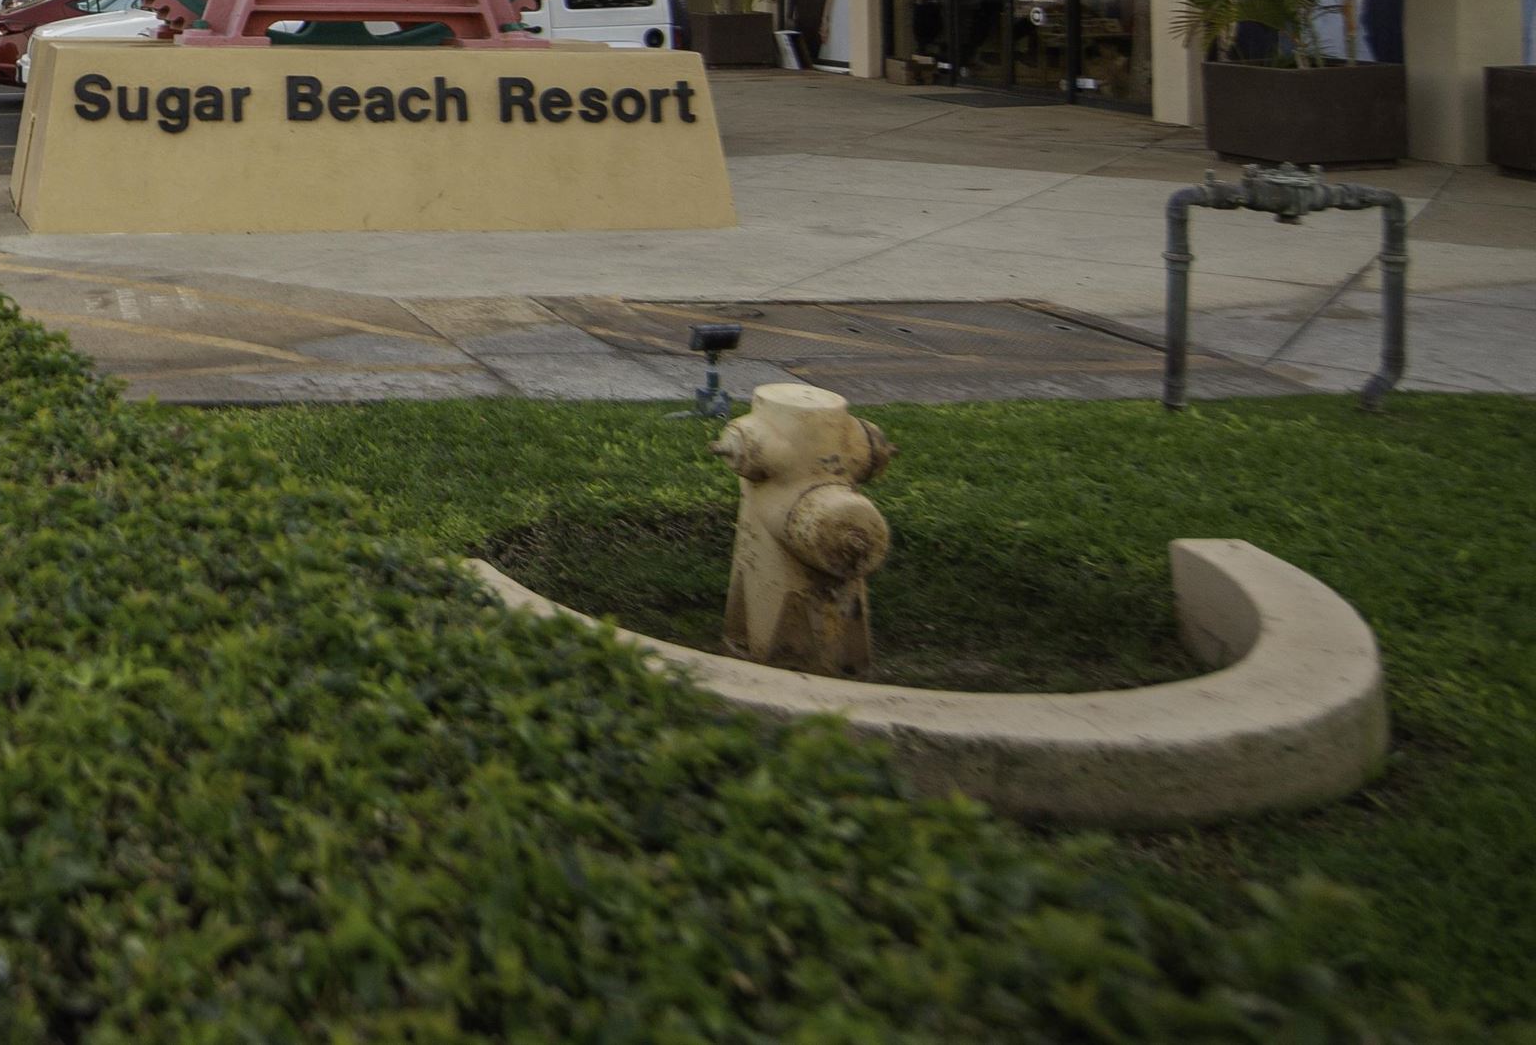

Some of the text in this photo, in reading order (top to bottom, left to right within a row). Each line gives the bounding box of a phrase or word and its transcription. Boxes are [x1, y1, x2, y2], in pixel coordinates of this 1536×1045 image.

[74, 73, 696, 134] Sugar Beach Resort
